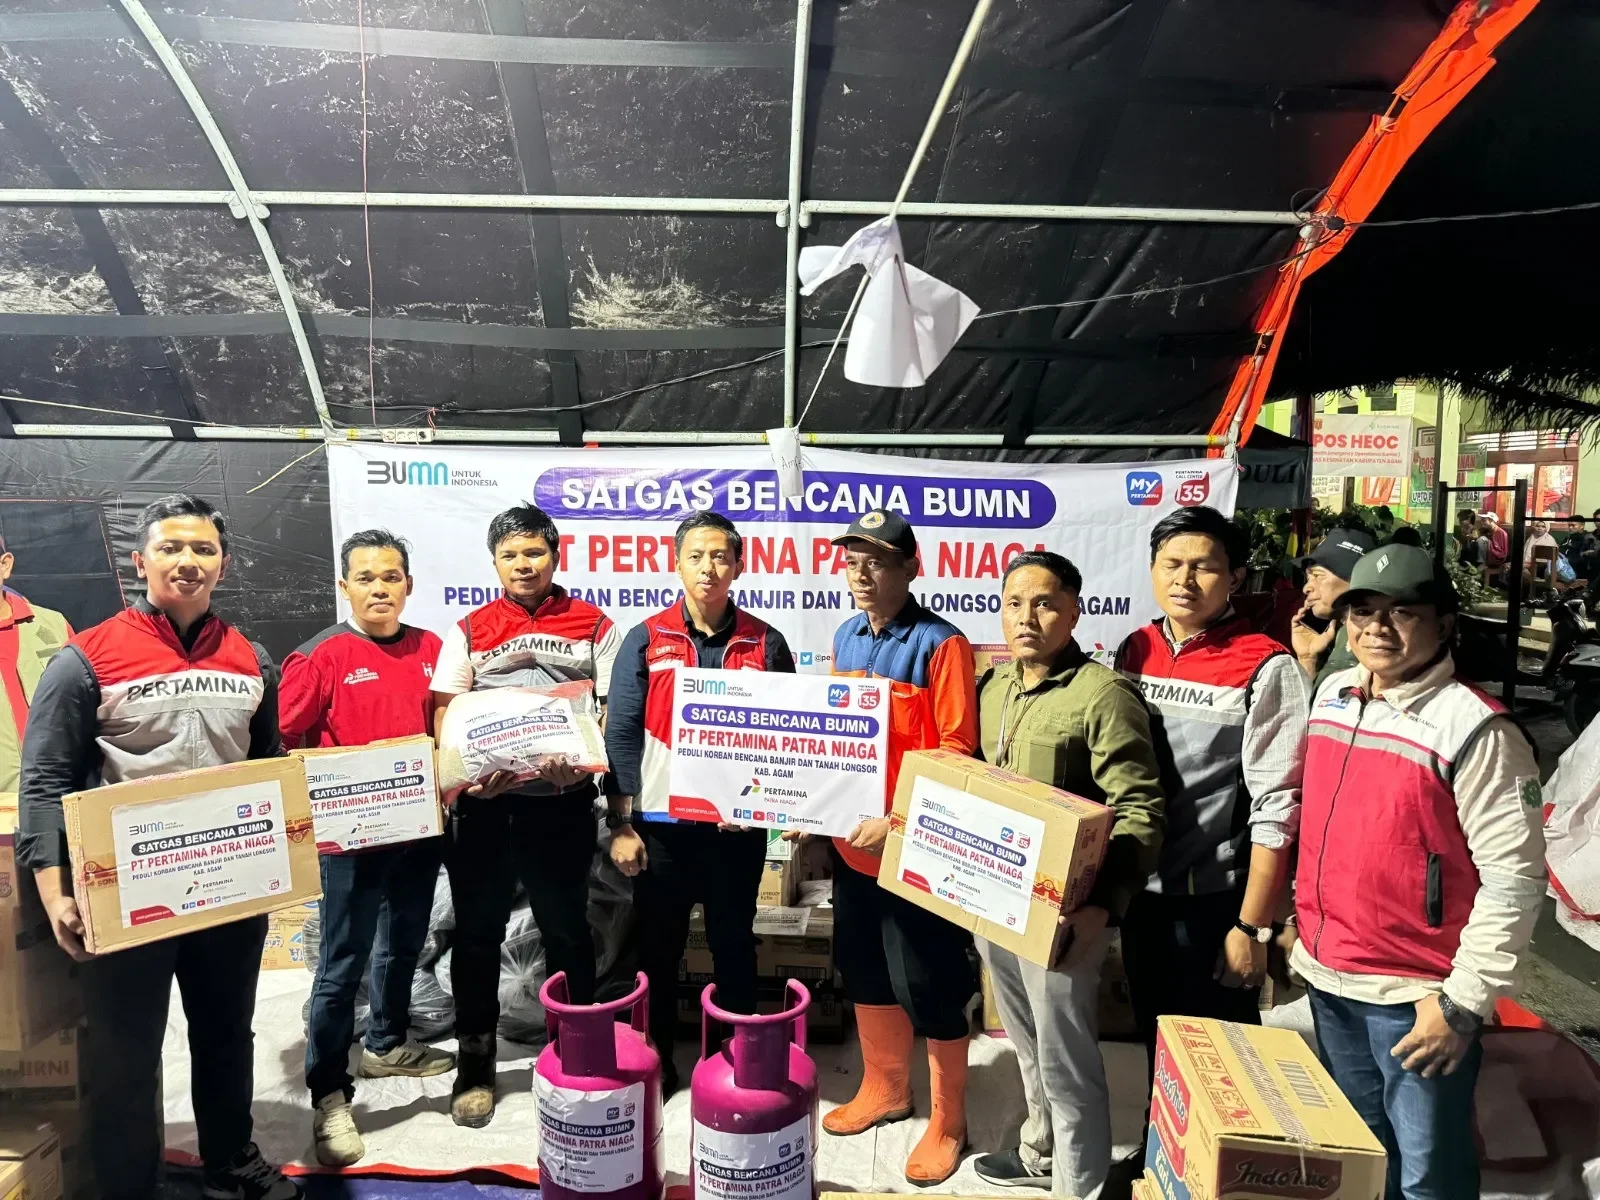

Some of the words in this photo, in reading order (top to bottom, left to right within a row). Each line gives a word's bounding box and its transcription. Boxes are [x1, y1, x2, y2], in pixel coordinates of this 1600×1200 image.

[1313, 434, 1347, 448] POS
[1351, 435, 1398, 449] HEOC
[367, 460, 448, 485] BUMN
[452, 470, 481, 478] UNTUK
[561, 478, 715, 511] SATGAS
[923, 487, 1030, 519] BUMN
[1175, 485, 1204, 501] 135
[589, 534, 800, 575] PERTINA
[802, 590, 841, 610] DAN
[921, 593, 1000, 613] LONGSO
[1077, 596, 1131, 615] AGAM
[126, 676, 250, 701] PERTAMINA
[683, 678, 726, 695] BUMN
[858, 695, 877, 707] 135
[471, 724, 501, 738] SATGAS
[502, 716, 541, 729] BENCANA
[542, 715, 564, 723] BUMN
[691, 708, 746, 724] SATGAS
[750, 712, 821, 730] BENCANA
[825, 718, 869, 734] BUMN
[467, 741, 476, 752] PT
[478, 731, 520, 747] PERTAMINA
[522, 724, 547, 736] PATRA
[678, 728, 695, 744] PT
[699, 729, 778, 752] PERTAMINA
[782, 736, 827, 755] PATRA
[831, 741, 878, 760] NIAGA
[677, 748, 702, 758] PEDULI
[704, 750, 733, 760] KORBAN
[734, 753, 768, 763] BENCANA
[770, 756, 796, 766] BANJIR
[798, 759, 813, 768] DAN
[815, 760, 840, 770] TANAH
[841, 763, 878, 774] LONGSOR
[754, 767, 770, 776] KAB.
[773, 769, 794, 778] AGAM
[314, 787, 349, 799] SATGAS
[351, 781, 392, 794] BENCANA
[394, 777, 419, 786] BUMN
[321, 796, 370, 810] PERTAMINA
[372, 791, 397, 803] PATRA
[400, 788, 425, 799] NIAGA
[764, 787, 808, 799] PERTAMINA
[129, 821, 164, 836] BUMN
[788, 815, 823, 825] @pertamina
[138, 837, 182, 853] SATGAS
[184, 828, 236, 844] BENCANA
[238, 822, 268, 834] BUMN
[922, 817, 953, 836] SATGAS
[955, 830, 995, 852] BENCANA
[997, 846, 1022, 864] BUMN
[131, 860, 143, 871] PT
[147, 848, 208, 868] PERTAMINA
[210, 840, 242, 856] PATRA
[244, 835, 275, 849] NIAGA
[913, 828, 923, 840] PT
[925, 832, 968, 859] PERTAMINA
[969, 850, 995, 870] PATRA
[997, 862, 1023, 881] NIAGA
[132, 872, 153, 881] PEDULI
[154, 867, 176, 877] KORBAN
[177, 863, 203, 872] BENCANA
[202, 878, 234, 889] PERTAMINA
[561, 1124, 602, 1135] BENCANA
[605, 1122, 631, 1134] BUMN
[580, 1139, 606, 1149] PATRA
[609, 1134, 634, 1147] NIAGA
[702, 1162, 732, 1178] SATGAS
[734, 1167, 777, 1179] BENCANA
[780, 1156, 801, 1172] BUMN
[700, 1172, 708, 1183] PT
[708, 1176, 753, 1193] PERTAMINA
[755, 1180, 782, 1193] PATRA
[784, 1166, 805, 1183] NIAGA
